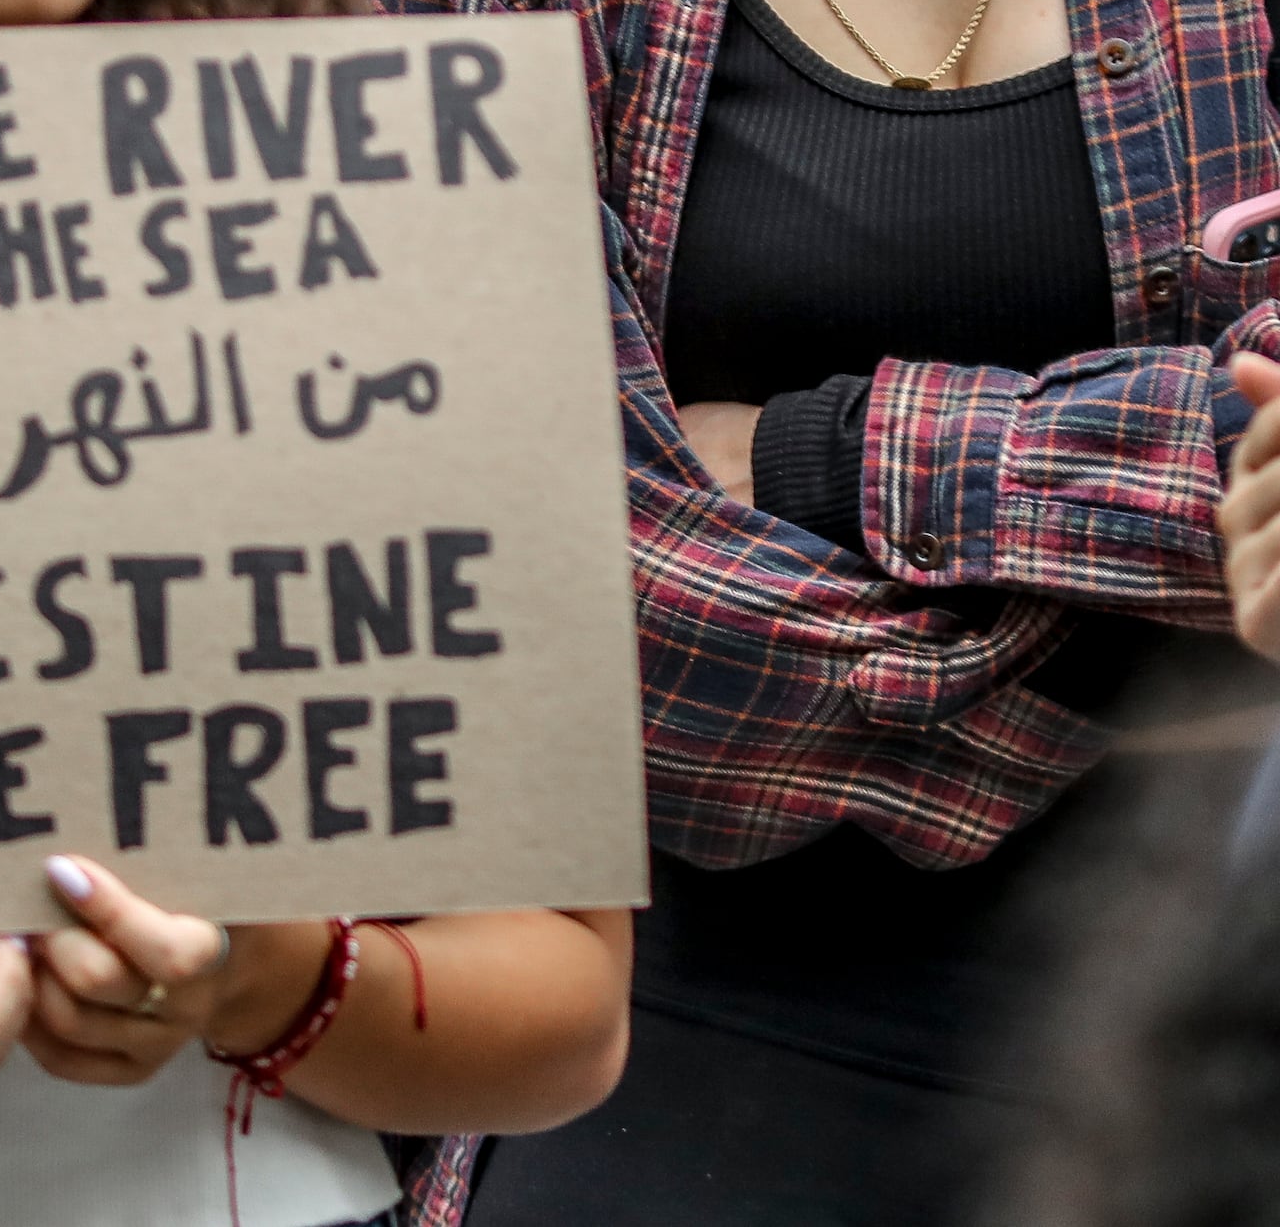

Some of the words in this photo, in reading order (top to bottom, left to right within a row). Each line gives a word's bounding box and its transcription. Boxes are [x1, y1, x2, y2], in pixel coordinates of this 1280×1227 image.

[100, 40, 521, 197] RIVER
[139, 193, 380, 301] SEA
[296, 351, 441, 441] من
[104, 697, 460, 852] FREE
